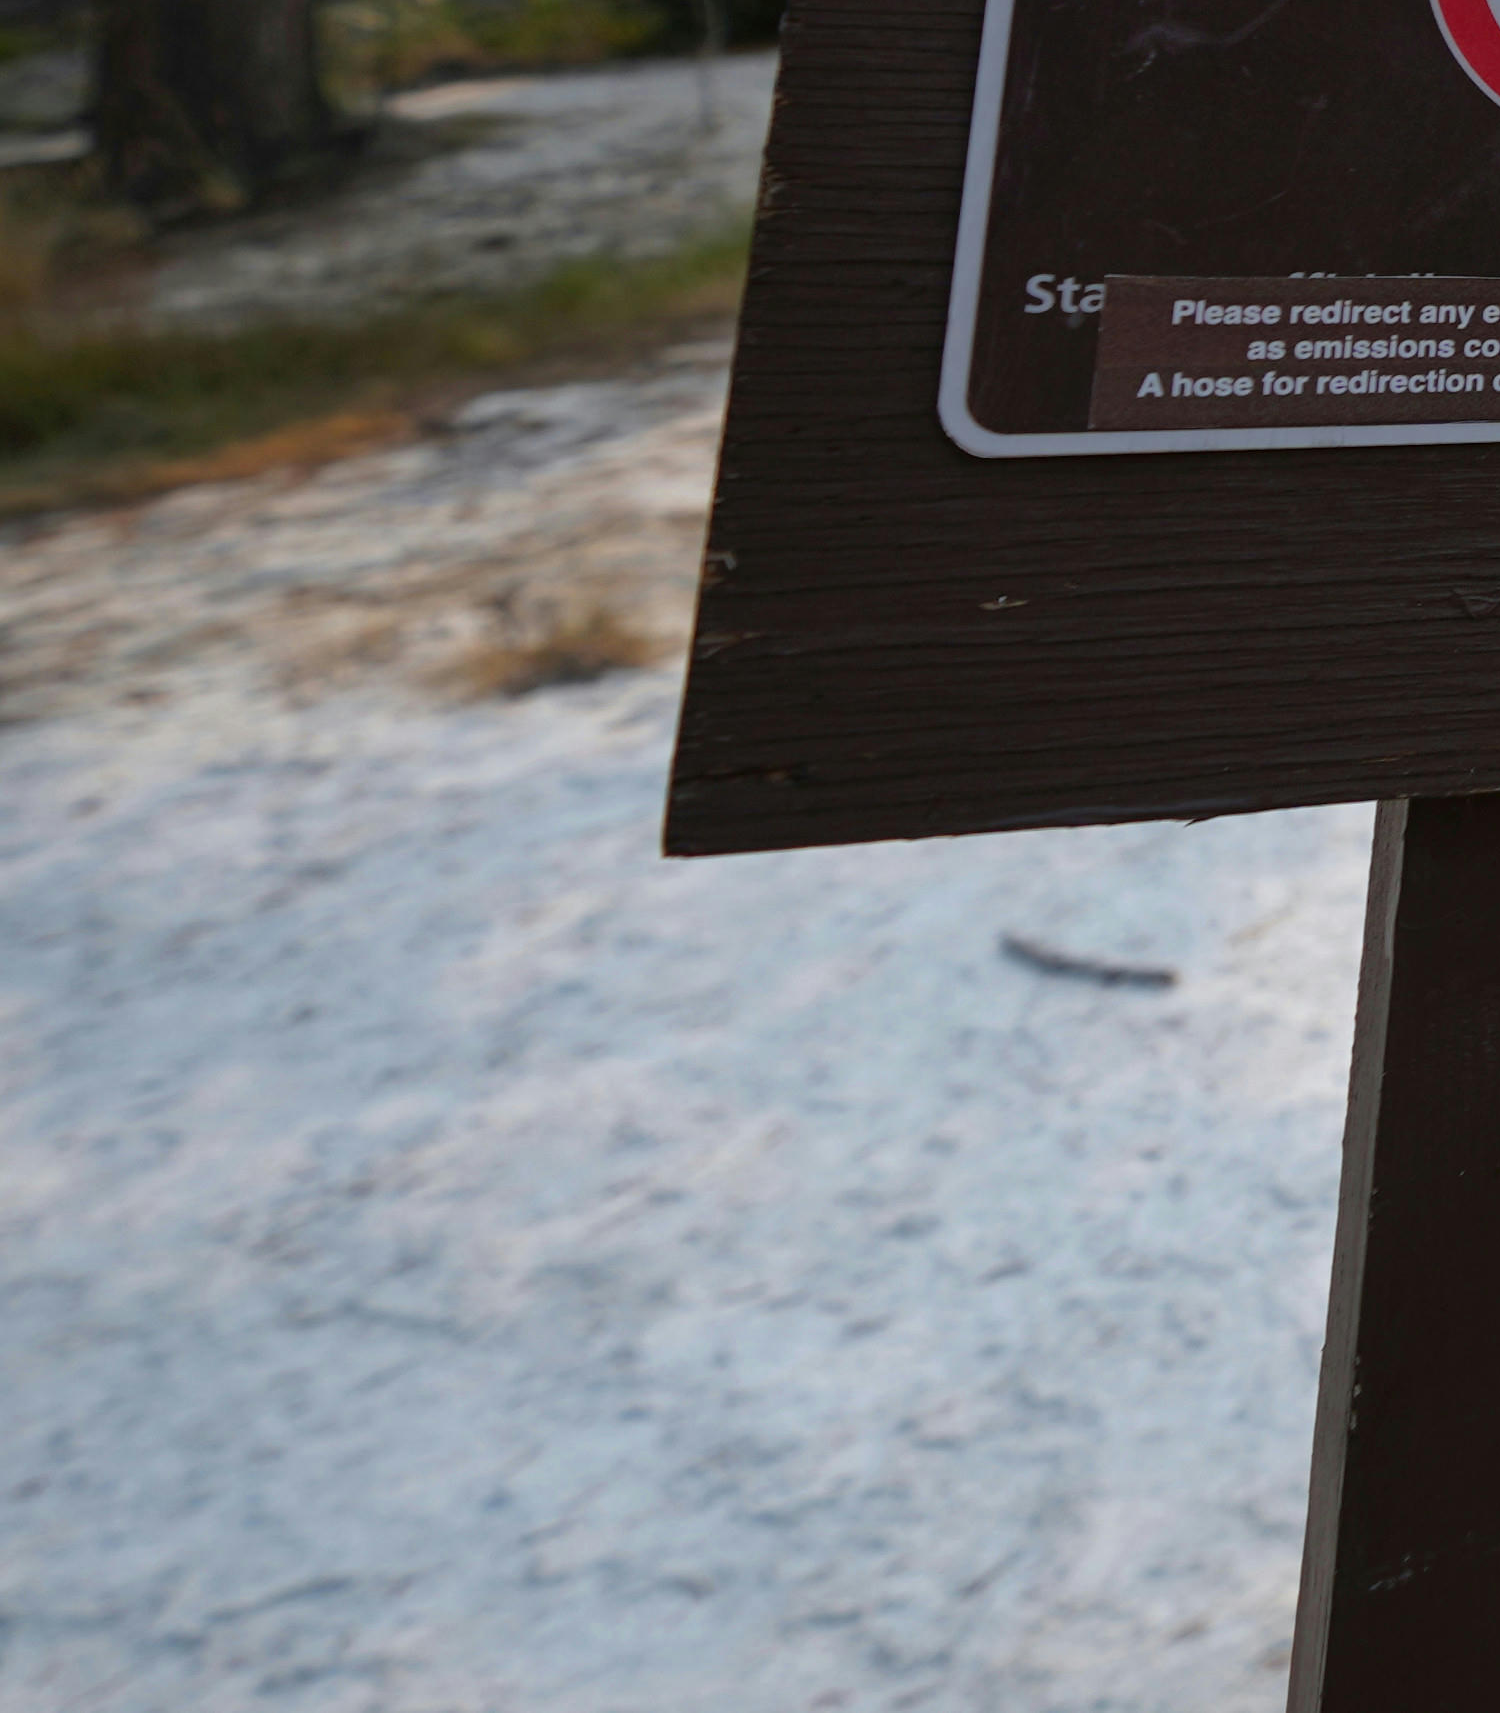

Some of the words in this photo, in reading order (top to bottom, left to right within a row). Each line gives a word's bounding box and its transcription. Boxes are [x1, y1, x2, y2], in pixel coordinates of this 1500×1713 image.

[1025, 274, 1104, 313] Sta
[1171, 300, 1282, 325] Please
[1289, 300, 1412, 325] redirect
[1418, 305, 1475, 329] any
[1246, 340, 1286, 361] as
[1293, 335, 1456, 360] emissions
[1136, 372, 1164, 398] A
[1171, 372, 1254, 397] hose
[1261, 370, 1310, 396] for
[1315, 368, 1485, 395] redirection
